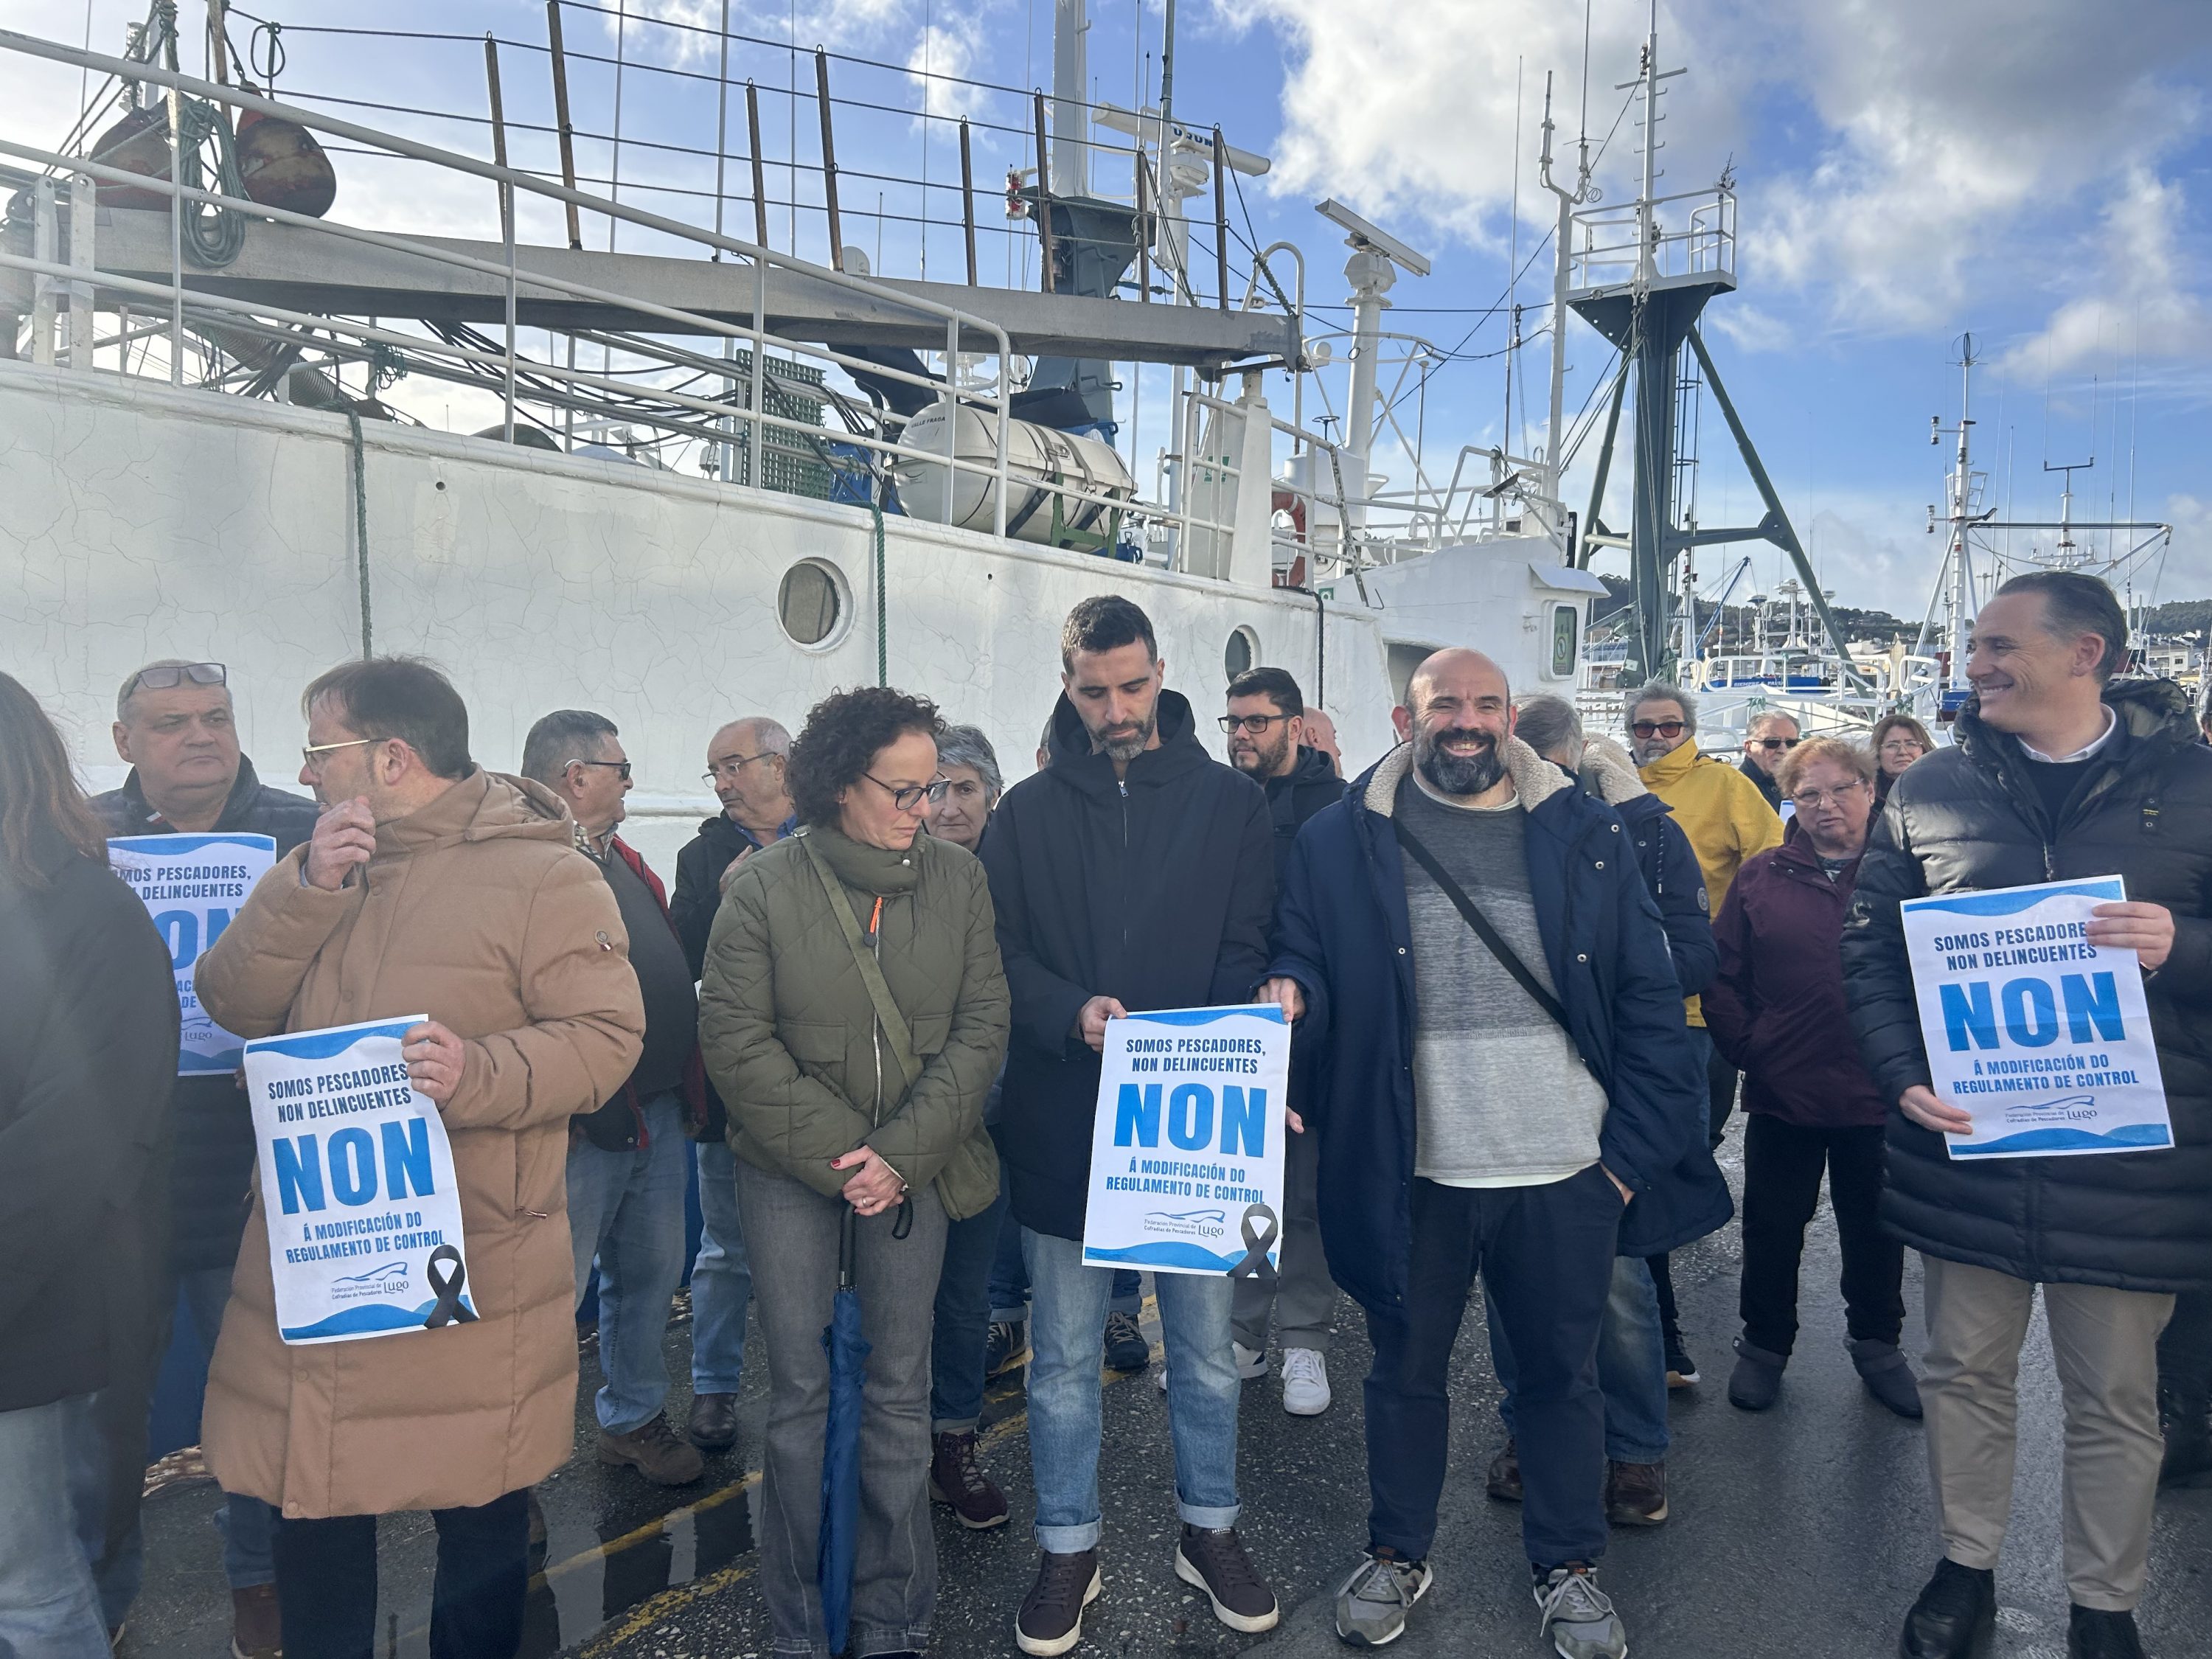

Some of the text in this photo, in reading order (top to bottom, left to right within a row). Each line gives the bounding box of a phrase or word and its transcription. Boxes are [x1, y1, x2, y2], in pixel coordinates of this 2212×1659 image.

[1173, 128, 1213, 147] URUN
[114, 865, 251, 883] MOS PESCADORES,
[142, 883, 243, 900] DELINCUENTES
[1934, 921, 2087, 952] SOMOS PESCADORE
[1946, 943, 2098, 971] NON DELINCUENTES
[181, 995, 197, 1008] DE
[1938, 971, 2126, 1052] NON
[184, 1032, 212, 1042] Lugo
[1126, 1038, 1266, 1057] SOMOS PESCADORES,
[1132, 1057, 1258, 1074] NON DELINCUENTES
[1973, 1054, 2110, 1076] Á MODIFICACIÓN DO
[268, 1077, 313, 1100] SOMOS
[1952, 1069, 2140, 1094] REGULAMENTO DE CONTROL
[277, 1086, 412, 1123] NON DELINCUENTES
[2067, 1109, 2098, 1121] Lugo
[1113, 1082, 1267, 1158] NON
[272, 1117, 436, 1215] NON
[1129, 1155, 1245, 1183] Á MODIFICACIÓN DO
[1106, 1176, 1265, 1204] REGULAMENTO DE CONTROL
[303, 1211, 422, 1242] Á MODIFICACIÓN DO
[1198, 1225, 1224, 1238] Lugo
[285, 1229, 446, 1264] REGULAMENTO DE CONTROL
[384, 1280, 409, 1294] Lugo
